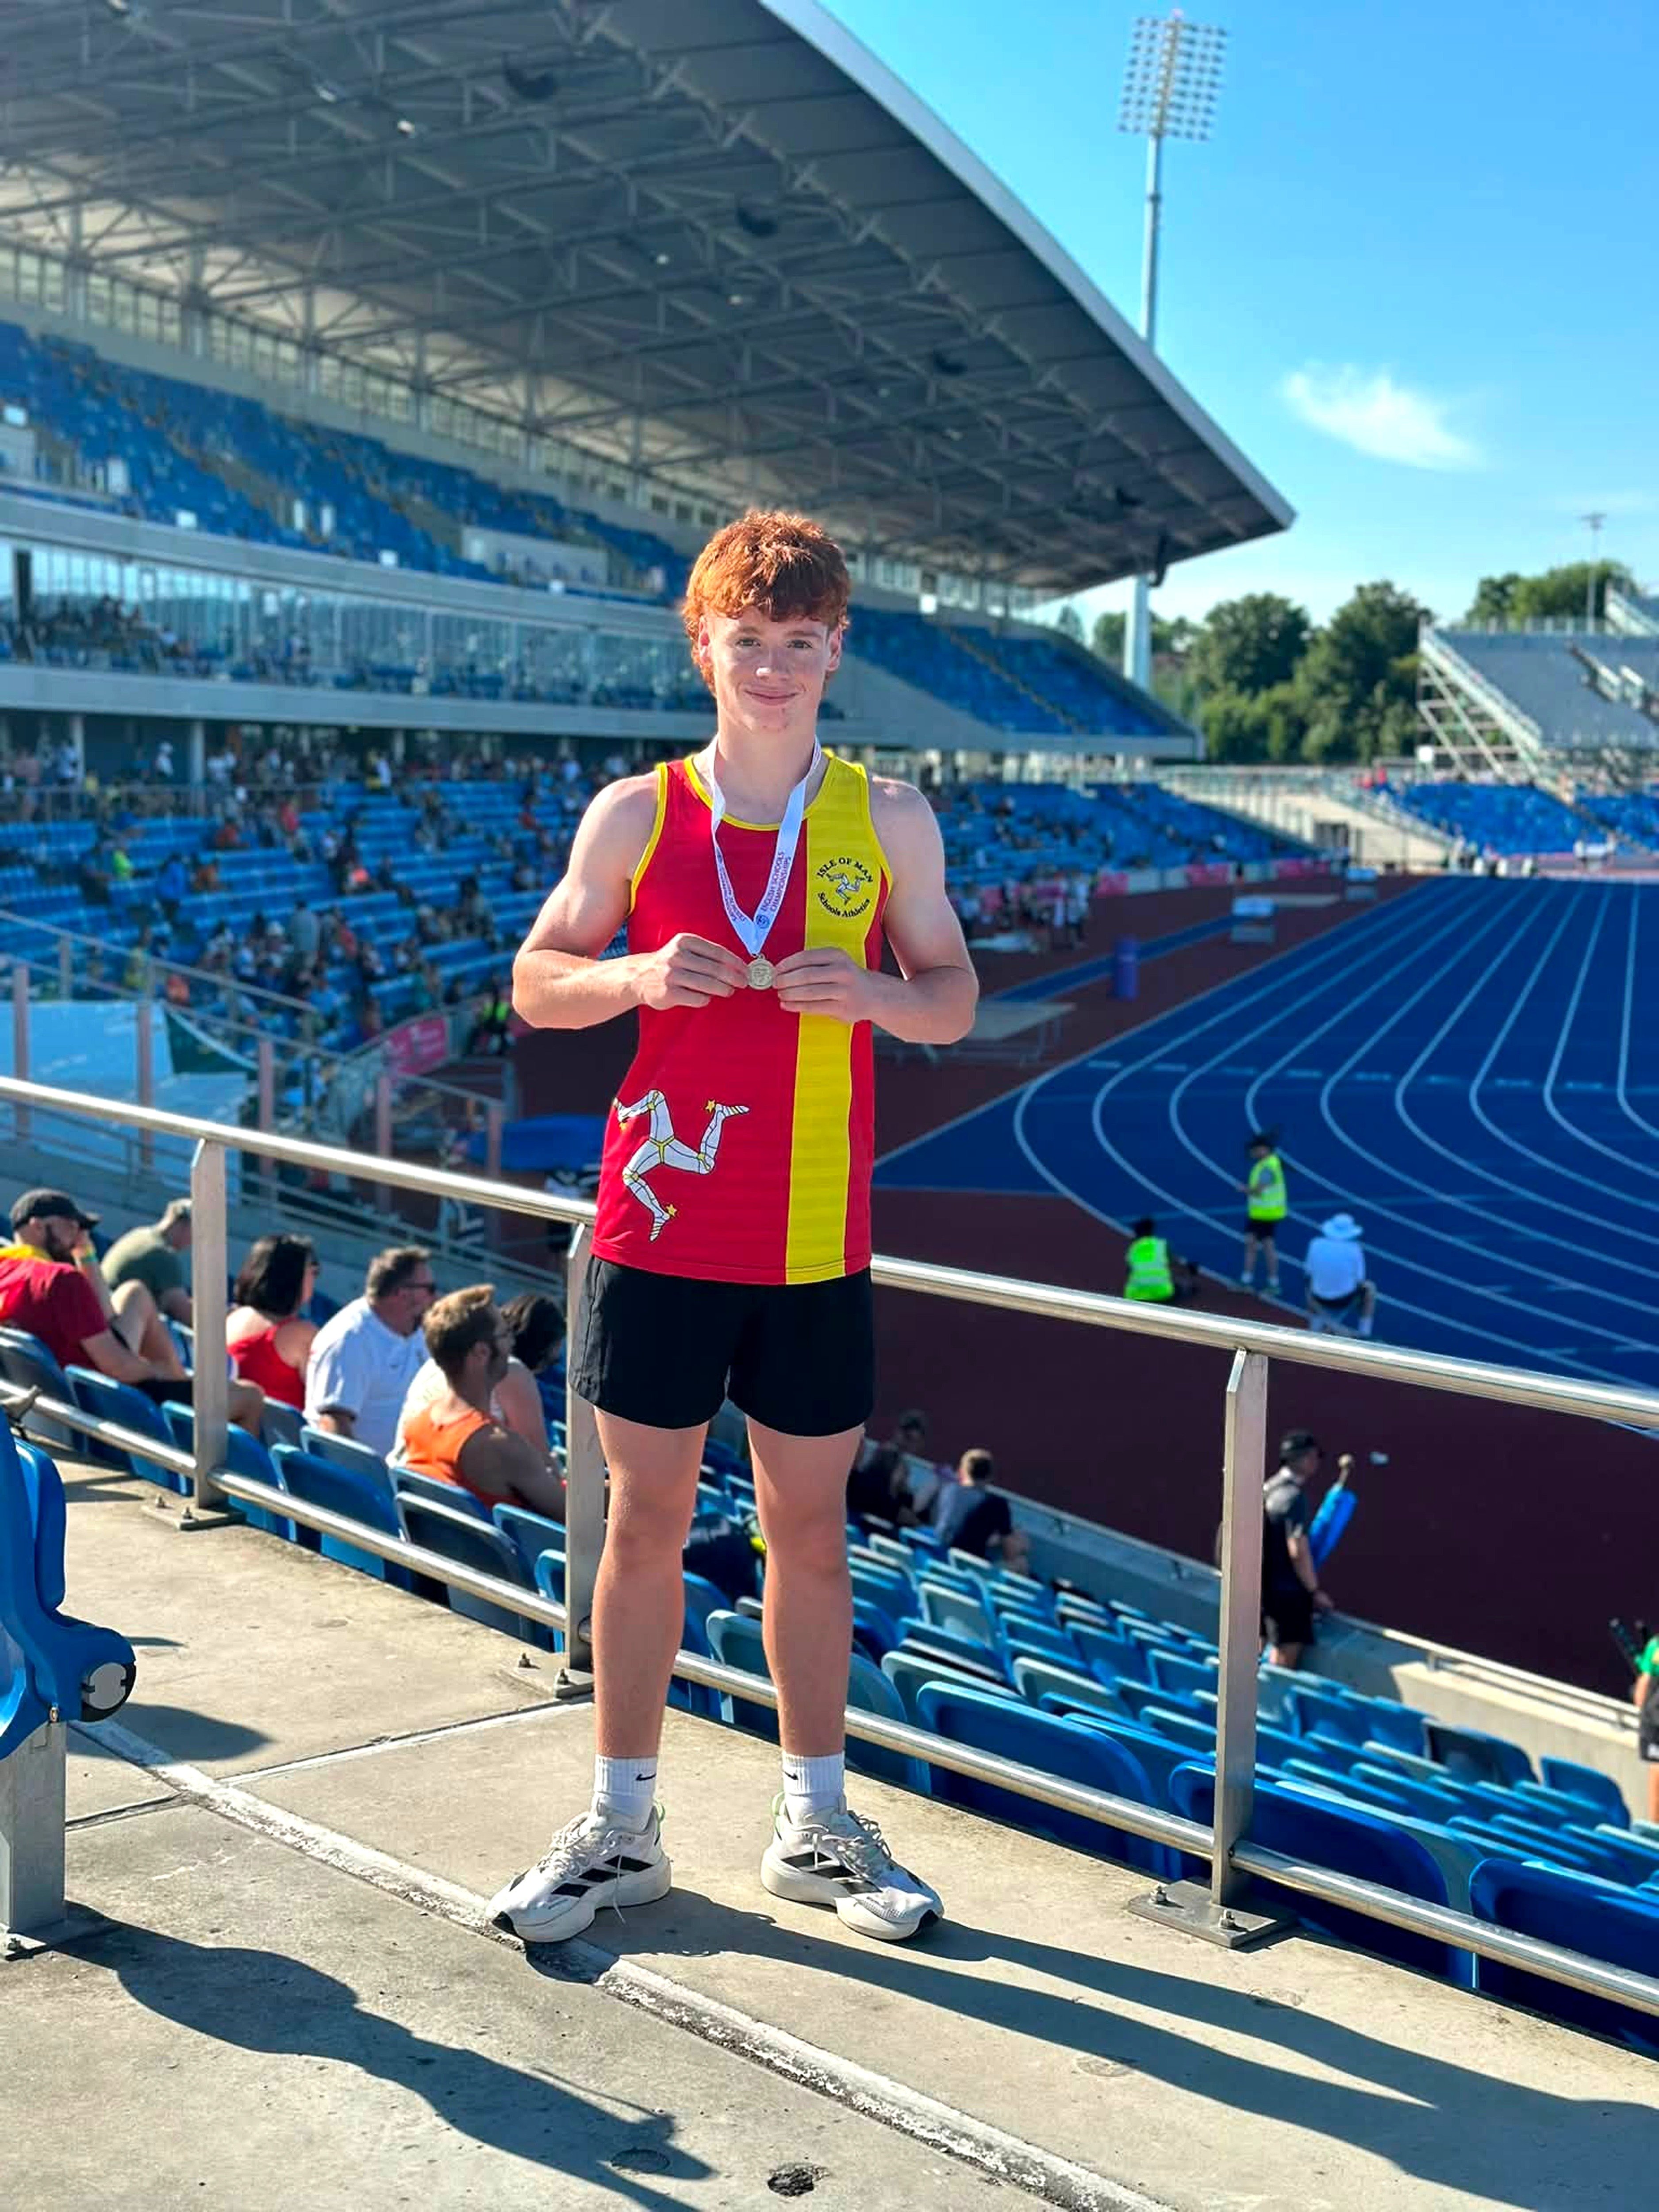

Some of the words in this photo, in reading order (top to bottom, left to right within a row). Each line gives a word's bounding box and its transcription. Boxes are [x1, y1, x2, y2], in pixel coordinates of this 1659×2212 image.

[771, 851, 784, 884] SCHOOLS
[817, 859, 837, 878] ISLE
[854, 861, 873, 882] MAN
[818, 892, 841, 916] Schools
